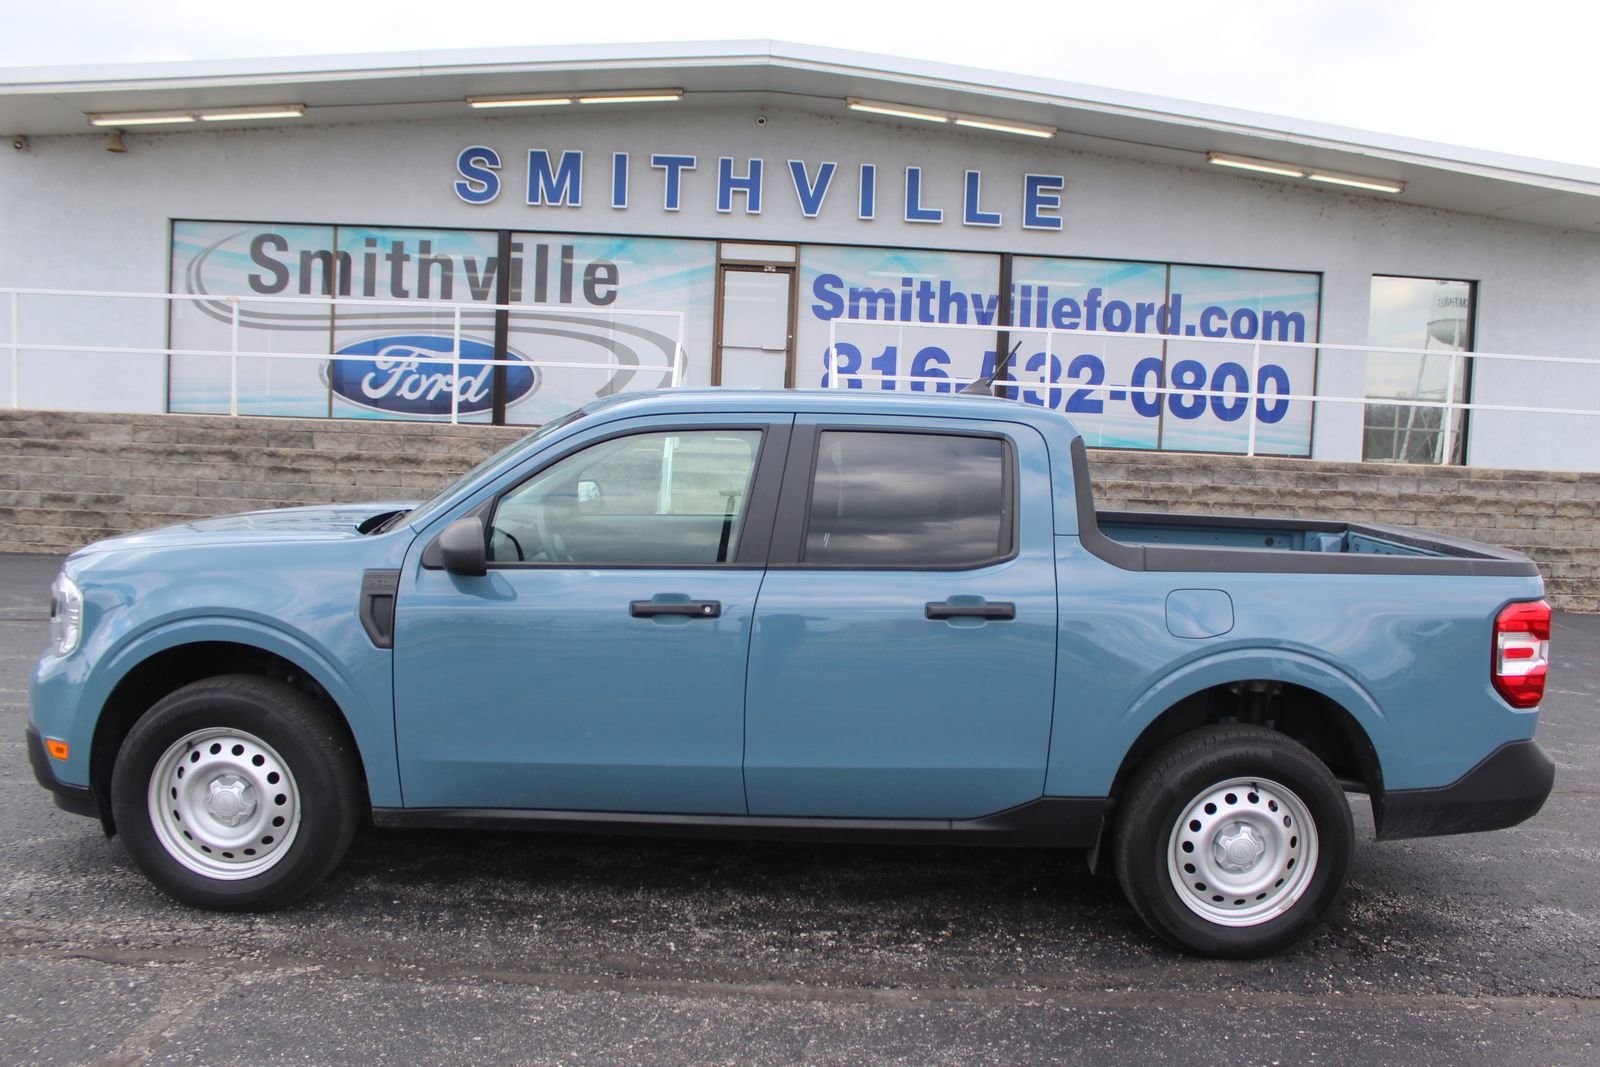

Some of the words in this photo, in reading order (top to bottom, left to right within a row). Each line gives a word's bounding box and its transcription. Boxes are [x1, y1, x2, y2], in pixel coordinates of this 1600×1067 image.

[454, 145, 1065, 230] SMITHVILLE
[247, 233, 620, 306] Smithville
[361, 345, 495, 403] Ford
[821, 342, 1290, 424] 816-532-0800
